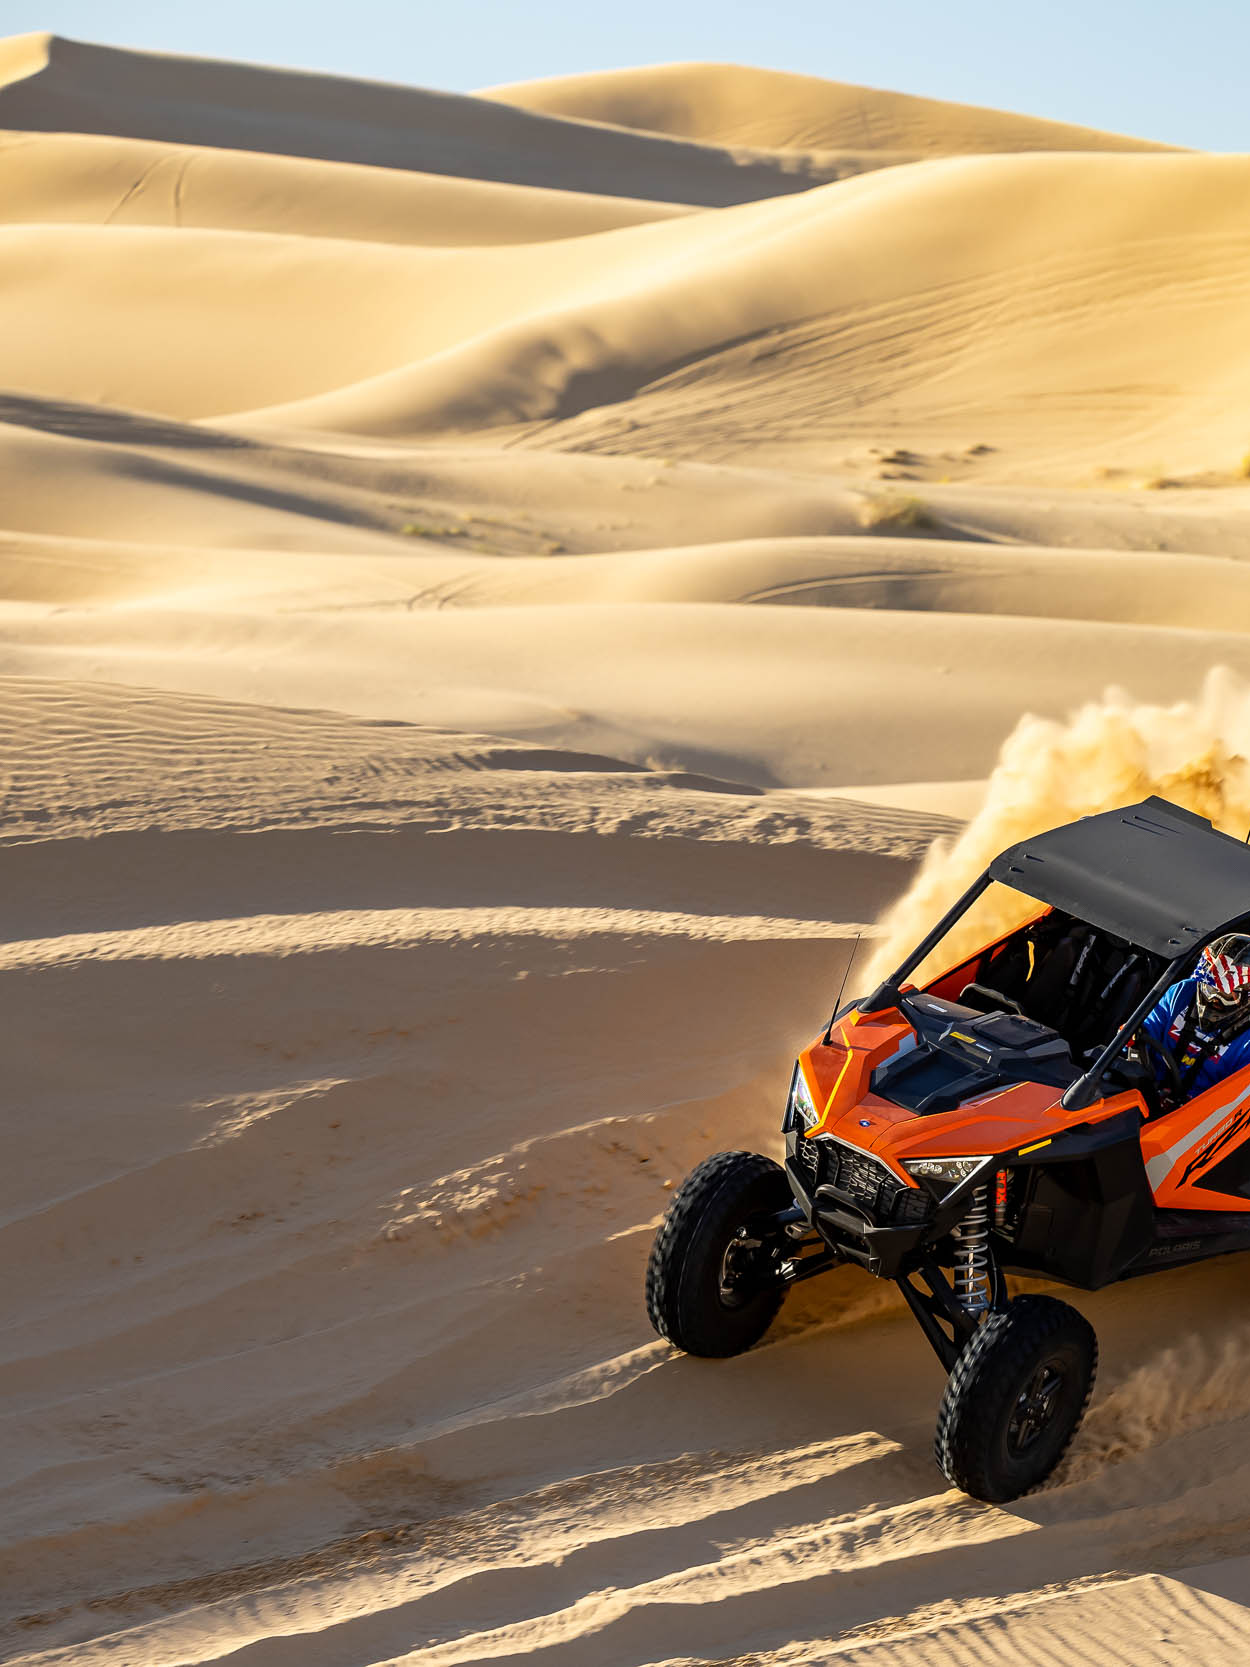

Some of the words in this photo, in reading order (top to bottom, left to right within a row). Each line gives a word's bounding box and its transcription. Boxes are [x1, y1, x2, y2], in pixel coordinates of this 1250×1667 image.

[1195, 1118, 1233, 1154] TURBO
[1233, 1109, 1243, 1121] R
[1148, 1240, 1201, 1257] POLARIS
